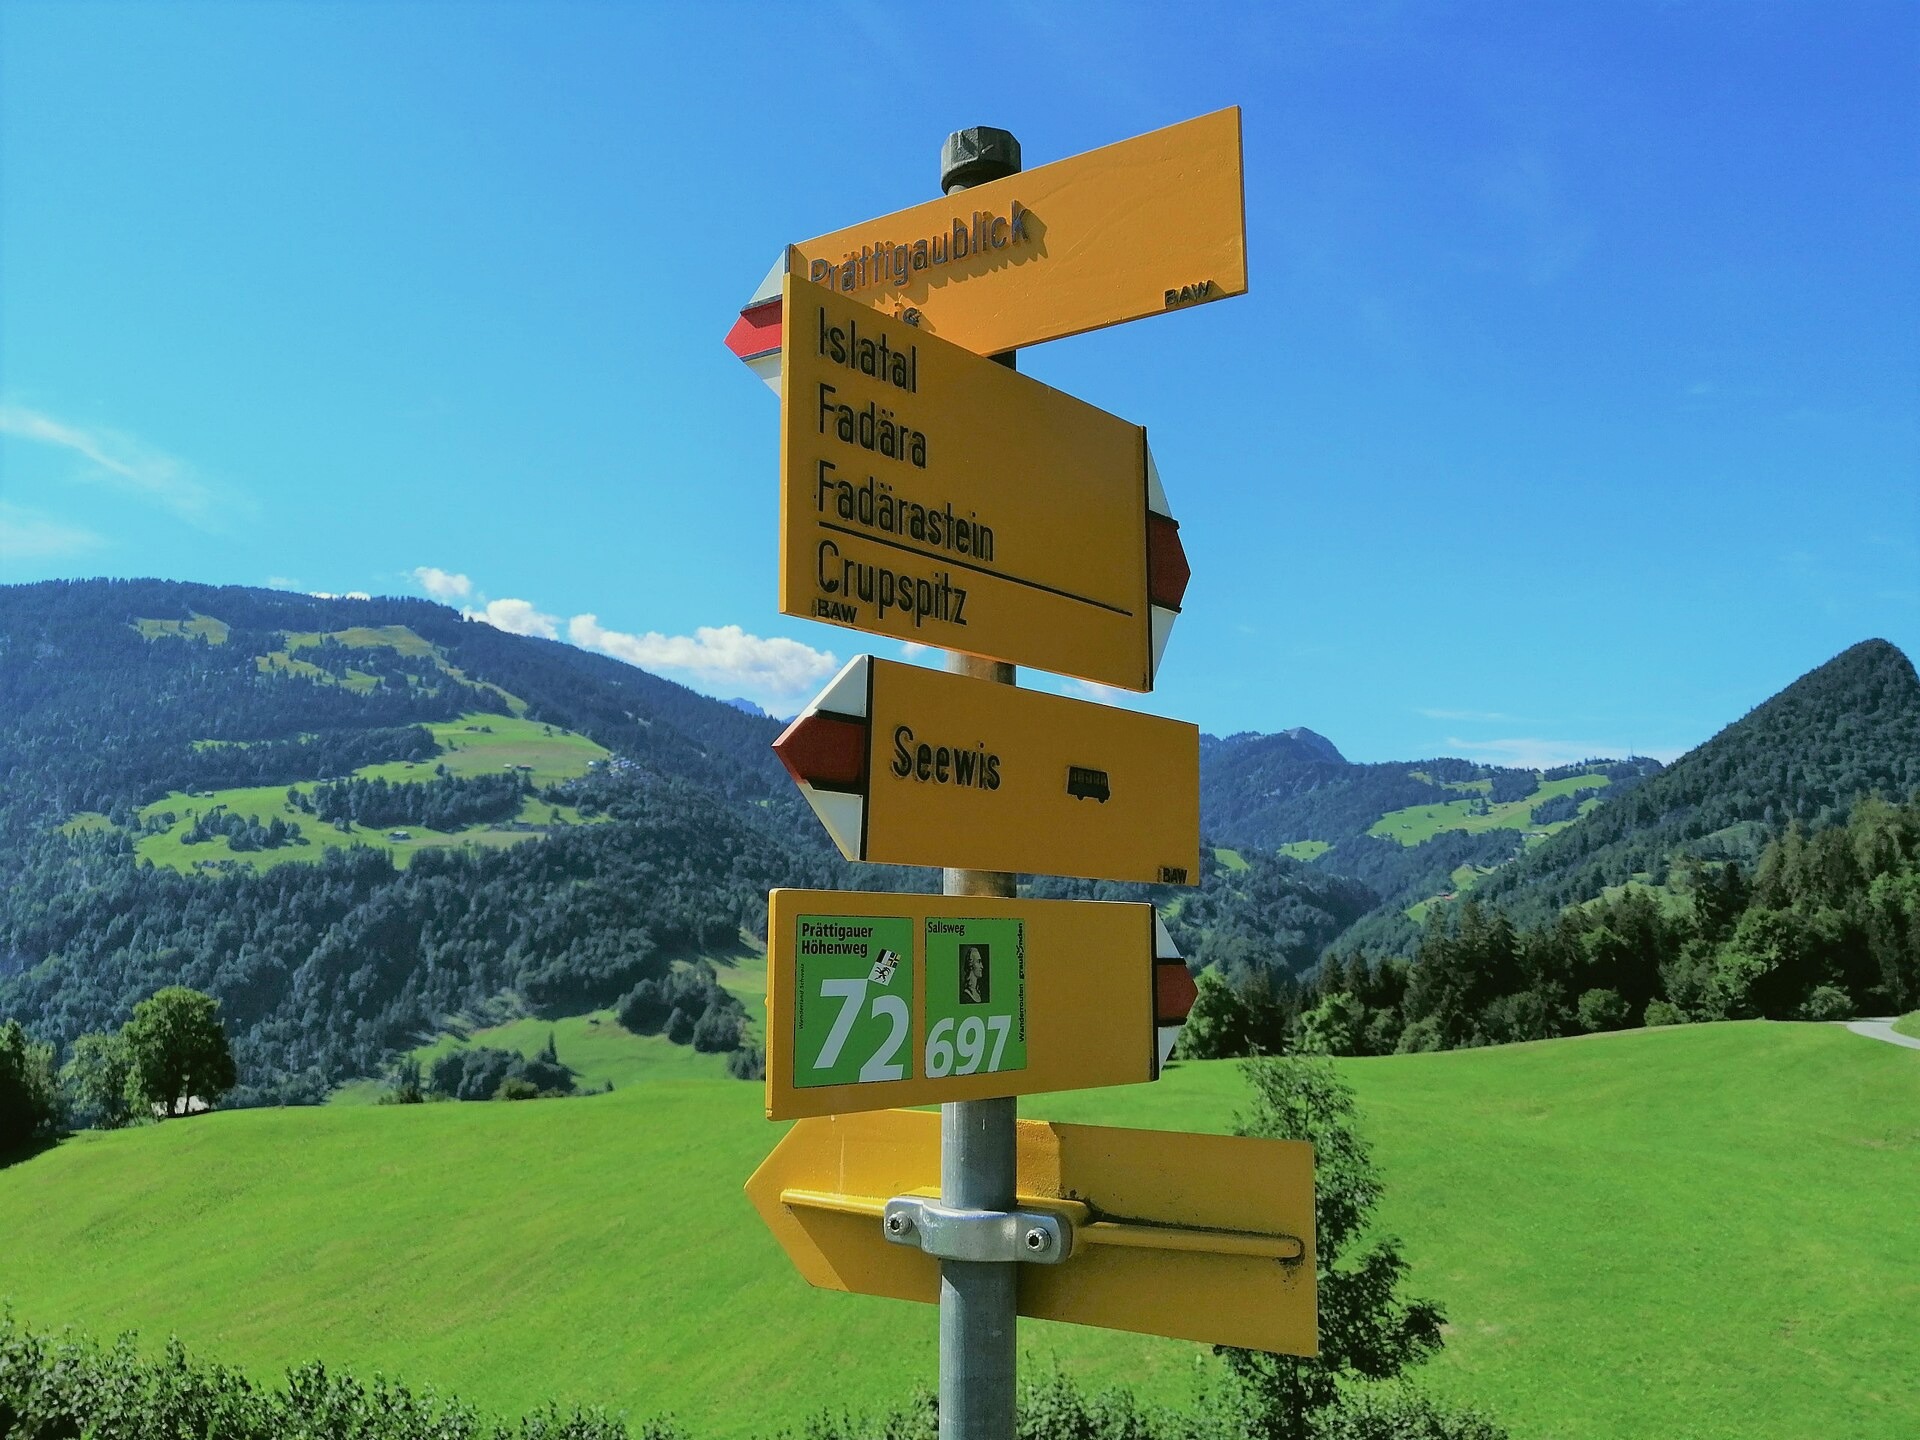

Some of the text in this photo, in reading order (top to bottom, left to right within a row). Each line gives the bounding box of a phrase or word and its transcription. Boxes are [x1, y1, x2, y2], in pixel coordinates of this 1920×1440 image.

[810, 199, 1030, 292] Prättigaublick
[1164, 280, 1212, 308] BAW
[818, 307, 917, 393] Islatal
[818, 383, 927, 469] Fadära
[818, 460, 995, 562] Fadärastein
[816, 599, 858, 624] BAW
[818, 540, 968, 627] Crupspitz
[891, 725, 1001, 791] Seewis
[1162, 867, 1188, 885] BAW
[801, 922, 873, 939] Prättigauer
[801, 940, 868, 958] Höhenweg
[812, 978, 910, 1083] 72
[1017, 984, 1025, 1042] Wanderrouten
[925, 1014, 1012, 1079] 697
